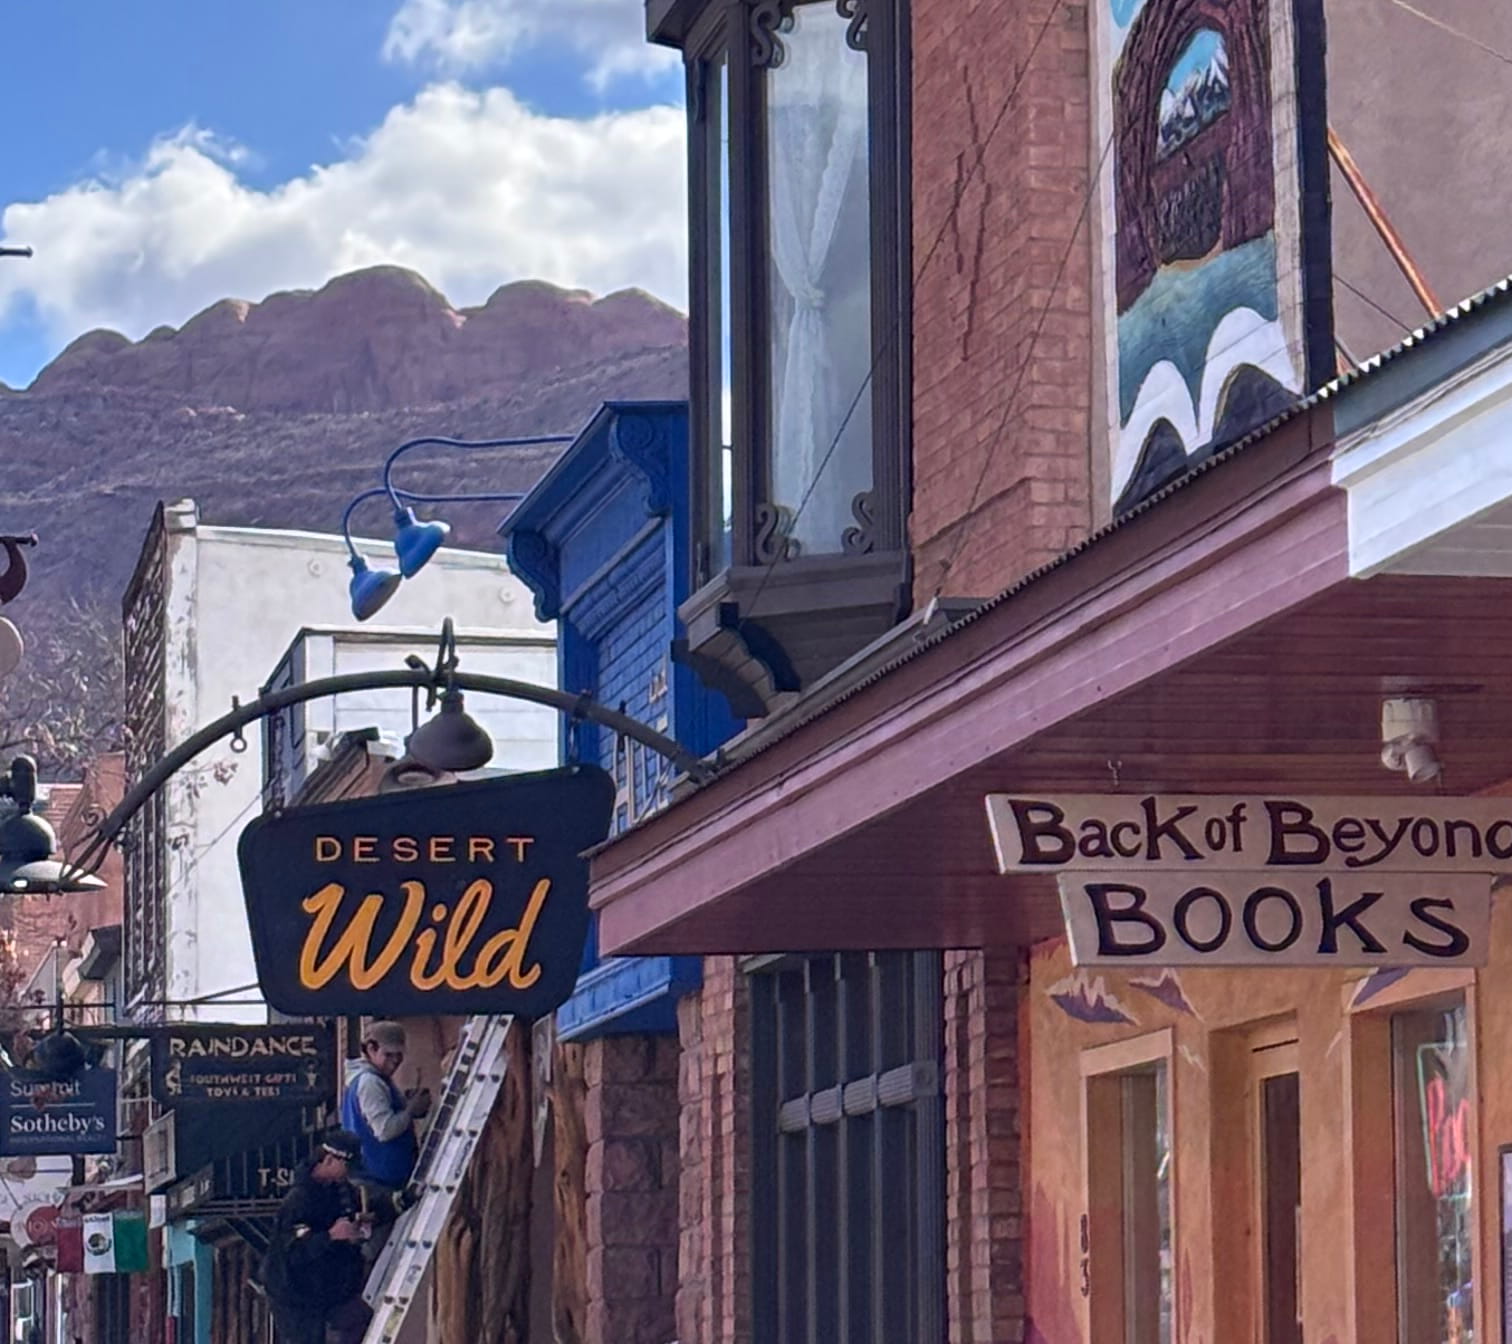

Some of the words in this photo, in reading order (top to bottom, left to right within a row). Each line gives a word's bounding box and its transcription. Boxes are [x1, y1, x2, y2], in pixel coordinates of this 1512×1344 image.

[1207, 803, 1247, 852] of
[315, 836, 535, 863] DESERT
[299, 878, 552, 991] Wild
[1082, 877, 1471, 958] BOOKS
[169, 1036, 318, 1057] RAINDANCE
[10, 1113, 105, 1135] Sotheby's
